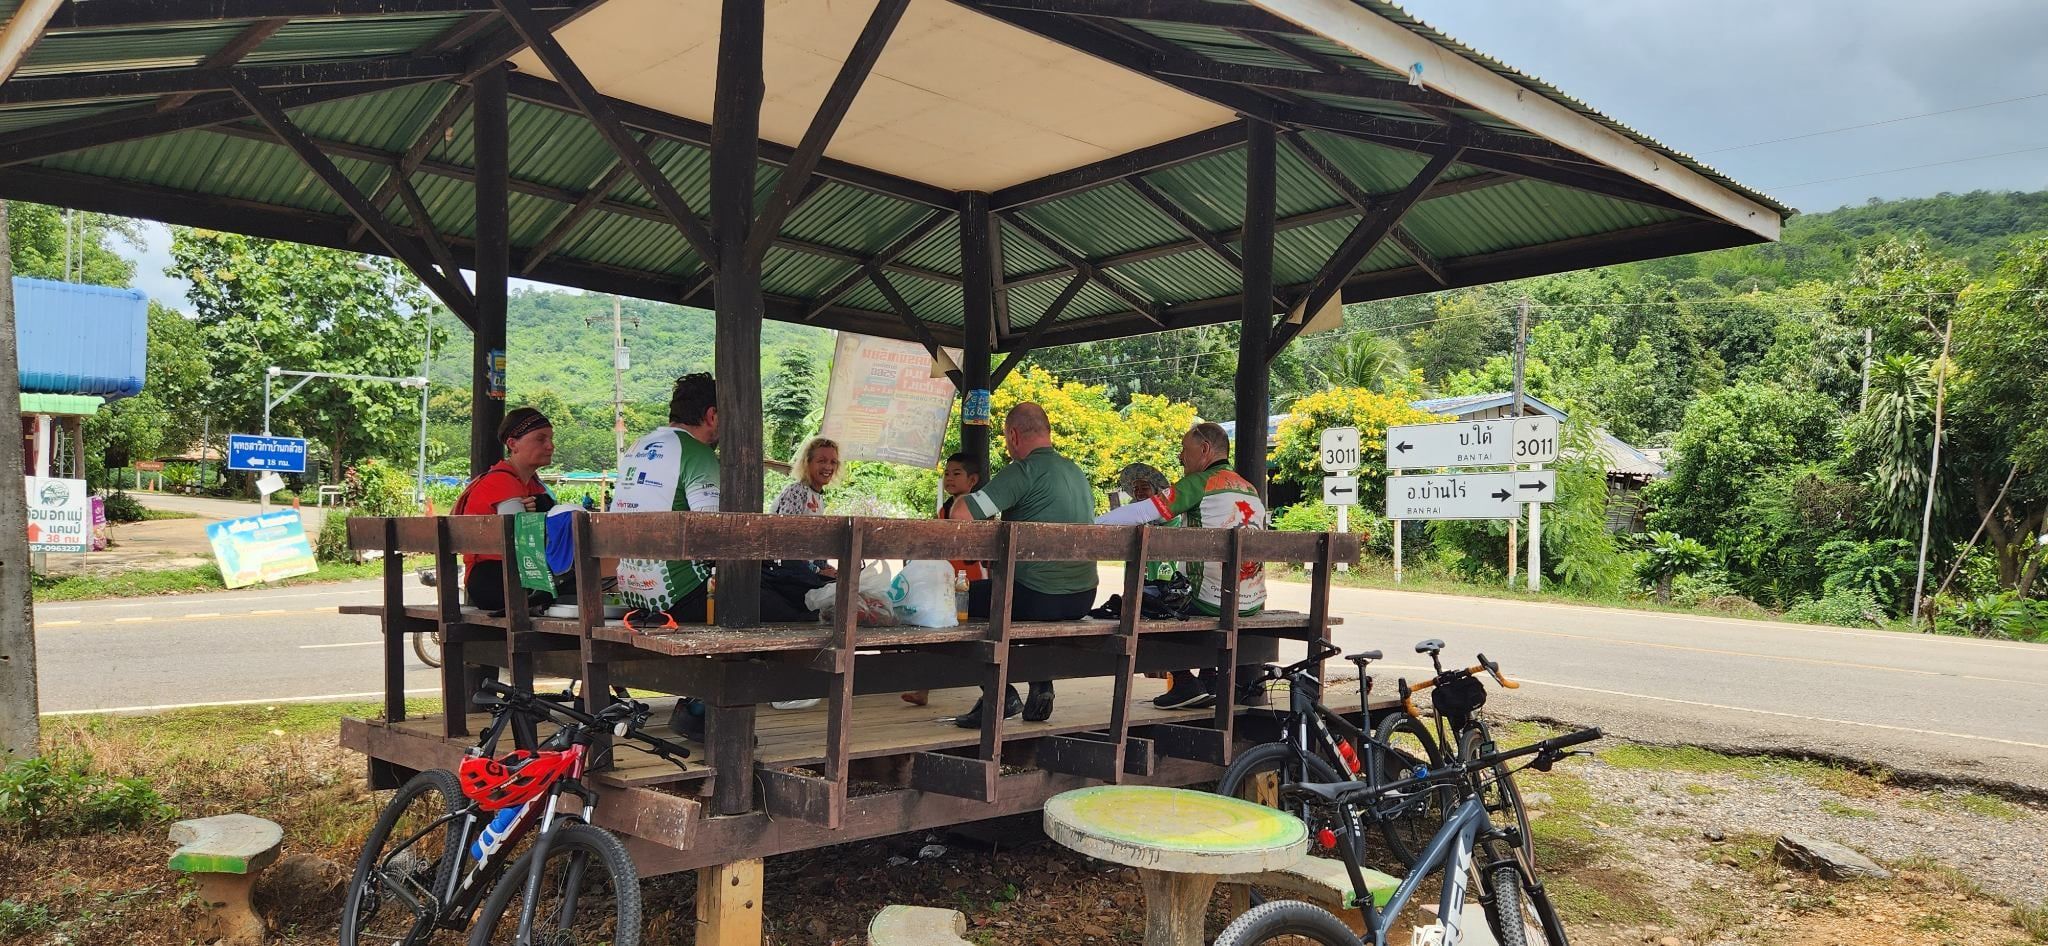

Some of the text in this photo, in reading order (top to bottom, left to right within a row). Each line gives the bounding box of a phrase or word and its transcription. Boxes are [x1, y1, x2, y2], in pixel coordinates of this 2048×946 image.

[1459, 424, 1493, 446] บ.ใต้
[1516, 438, 1553, 456] 3011
[1326, 448, 1356, 464] 3011
[1457, 453, 1492, 462] BAN TAI
[1407, 478, 1467, 500] อ.บ้านไร่
[49, 522, 81, 534] แคมป์
[46, 534, 60, 543] 38
[1347, 803, 1361, 837] AXXIS
